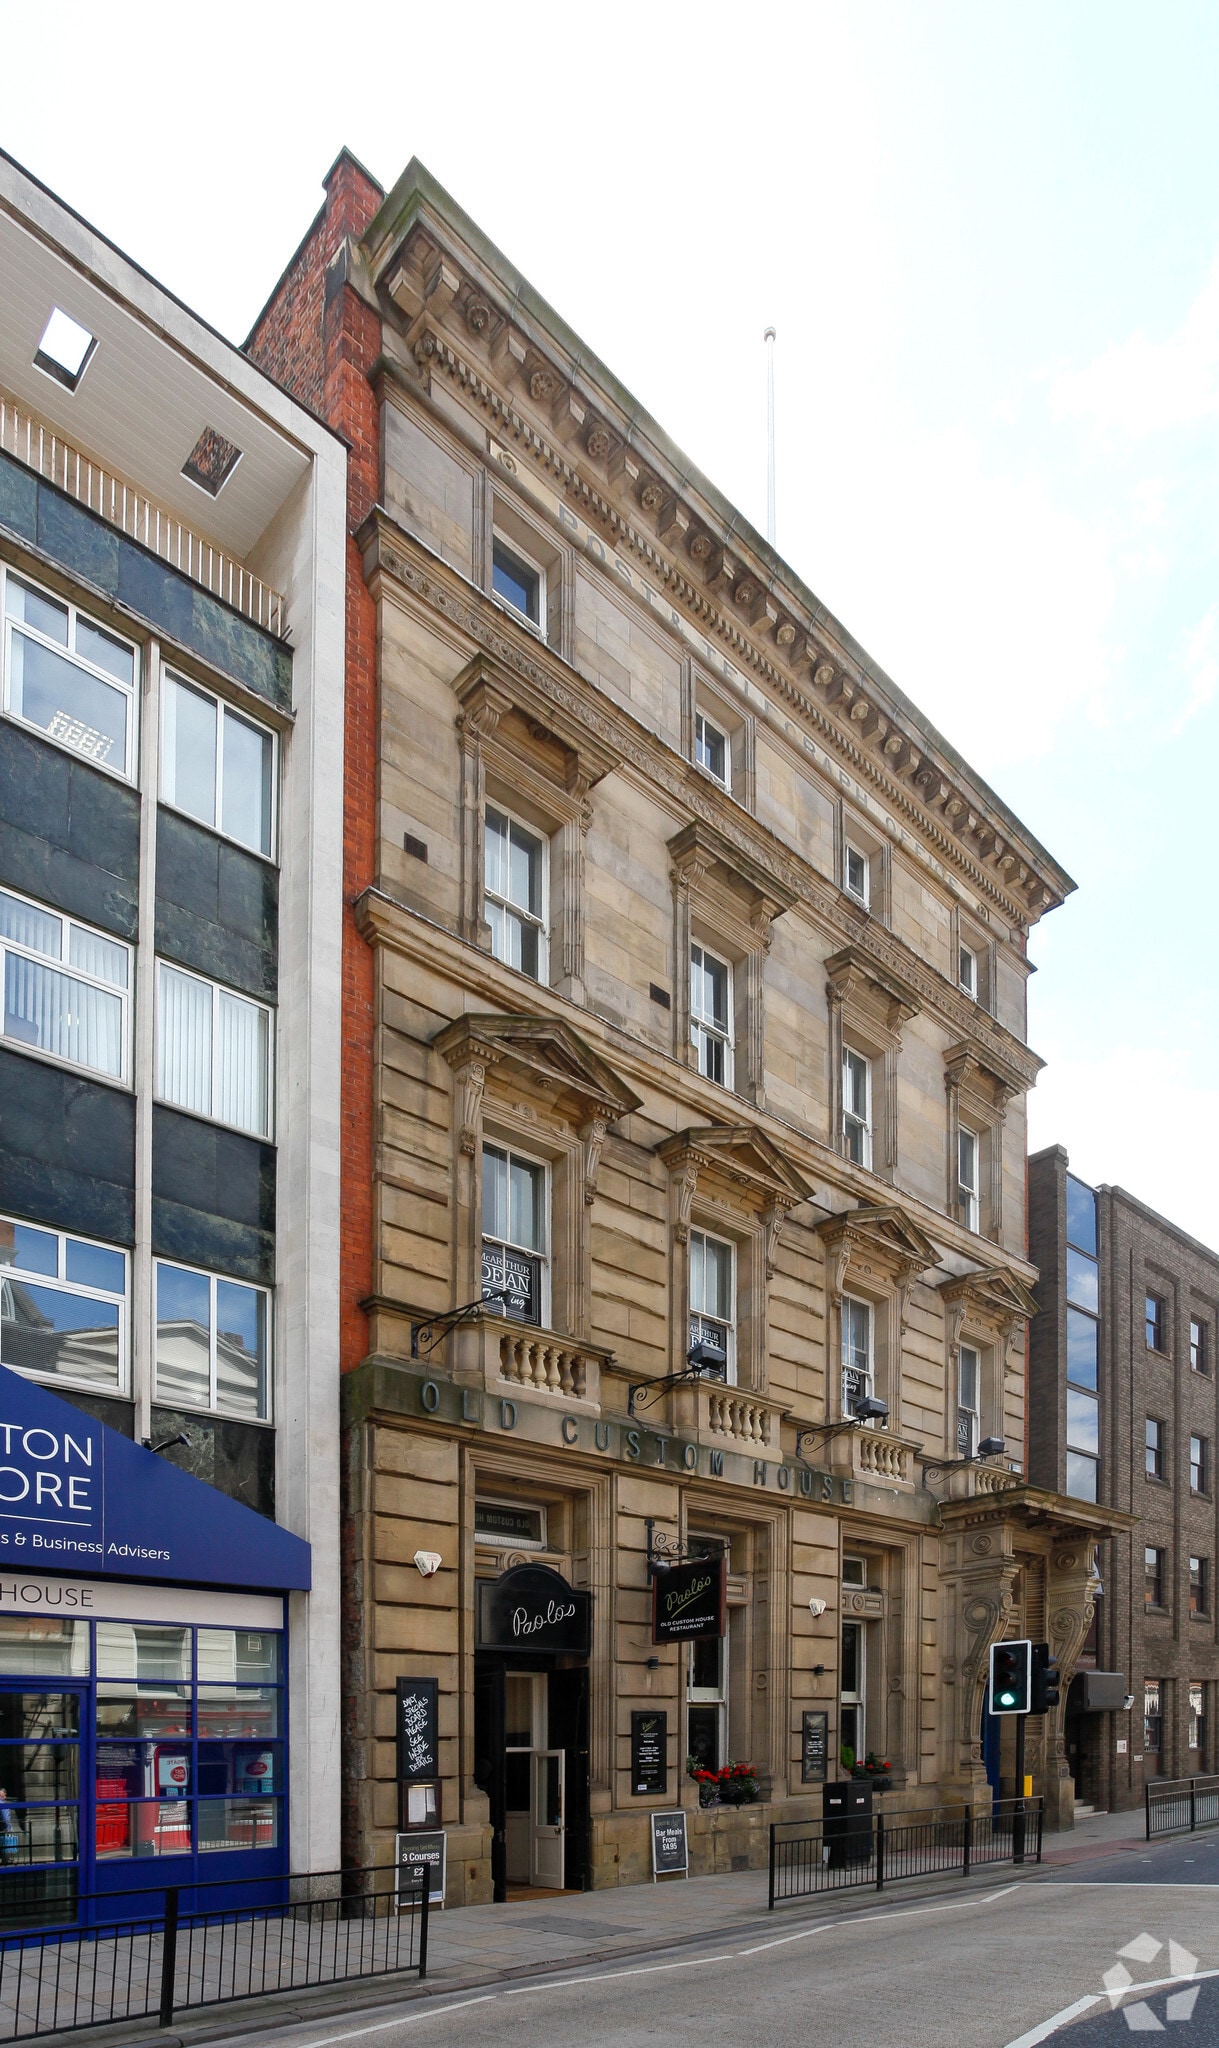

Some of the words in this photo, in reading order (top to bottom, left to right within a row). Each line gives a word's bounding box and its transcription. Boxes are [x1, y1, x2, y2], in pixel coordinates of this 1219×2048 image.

[481, 1263, 530, 1293] DEAN
[0, 1423, 92, 1467] TON
[421, 1381, 518, 1430] OLD
[562, 1416, 724, 1477] CUSTOM
[753, 1460, 853, 1504] HOUSE
[0, 1466, 92, 1511] ORE
[14, 1532, 27, 1546] &
[32, 1534, 104, 1554] Business
[107, 1542, 171, 1561] Advisers
[0, 1582, 94, 1608] HOUSE
[669, 1622, 705, 1632] RESTAURANT
[672, 1618, 695, 1626] CUSTOM
[695, 1615, 715, 1623] HOUSE
[404, 1708, 428, 1727] BOARD
[404, 1718, 428, 1737] PLEASE
[409, 1734, 424, 1747] SEE
[408, 1740, 430, 1761] INSIDE
[408, 1754, 434, 1772] DETAILS
[655, 1829, 666, 1837] Bar
[666, 1827, 682, 1836] Meals
[662, 1836, 677, 1844] From
[402, 1853, 408, 1862] 3
[409, 1852, 440, 1861] Courses
